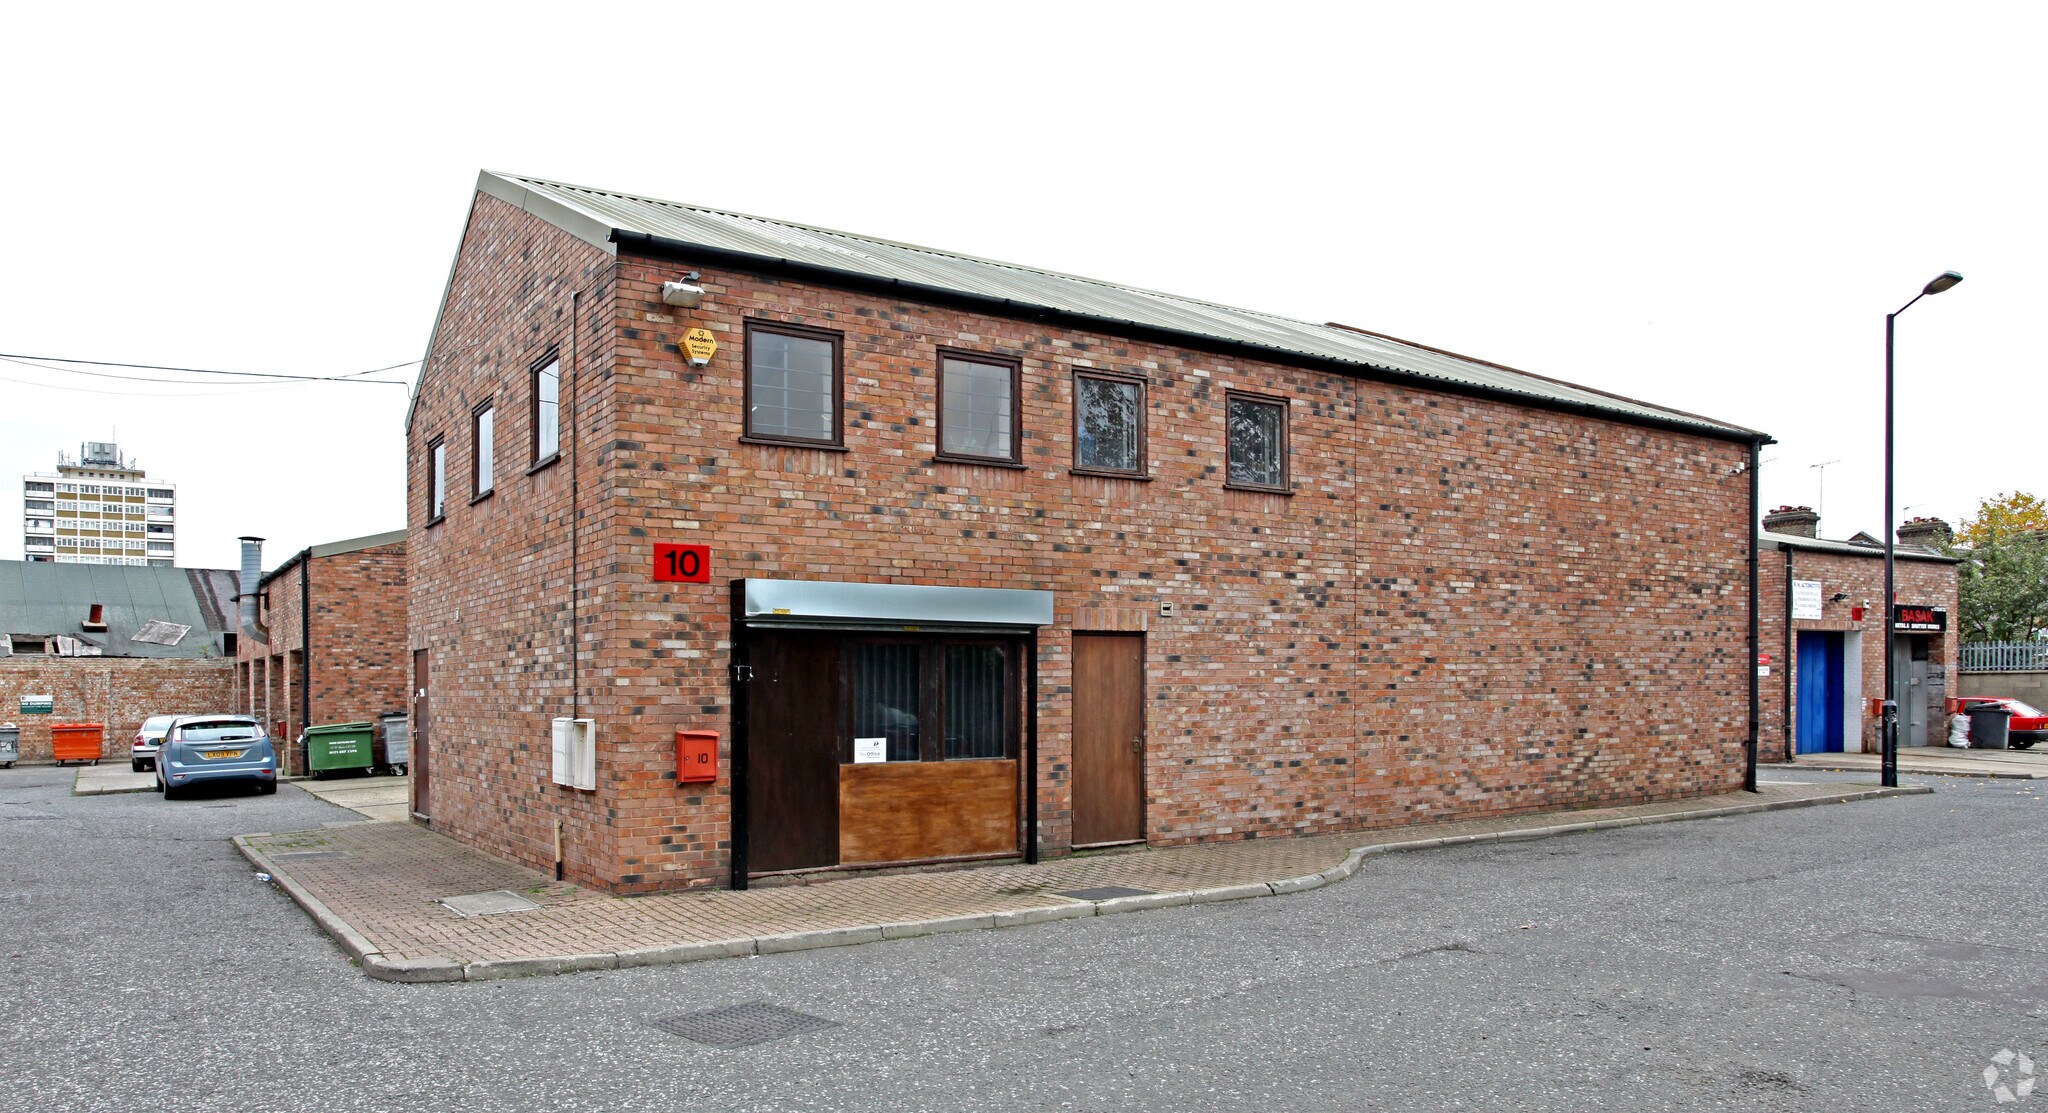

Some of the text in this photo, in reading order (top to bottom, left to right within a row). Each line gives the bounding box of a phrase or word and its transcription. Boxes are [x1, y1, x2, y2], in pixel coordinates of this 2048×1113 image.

[689, 335, 714, 344] Modern
[664, 549, 700, 577] 10
[697, 753, 709, 764] 10
